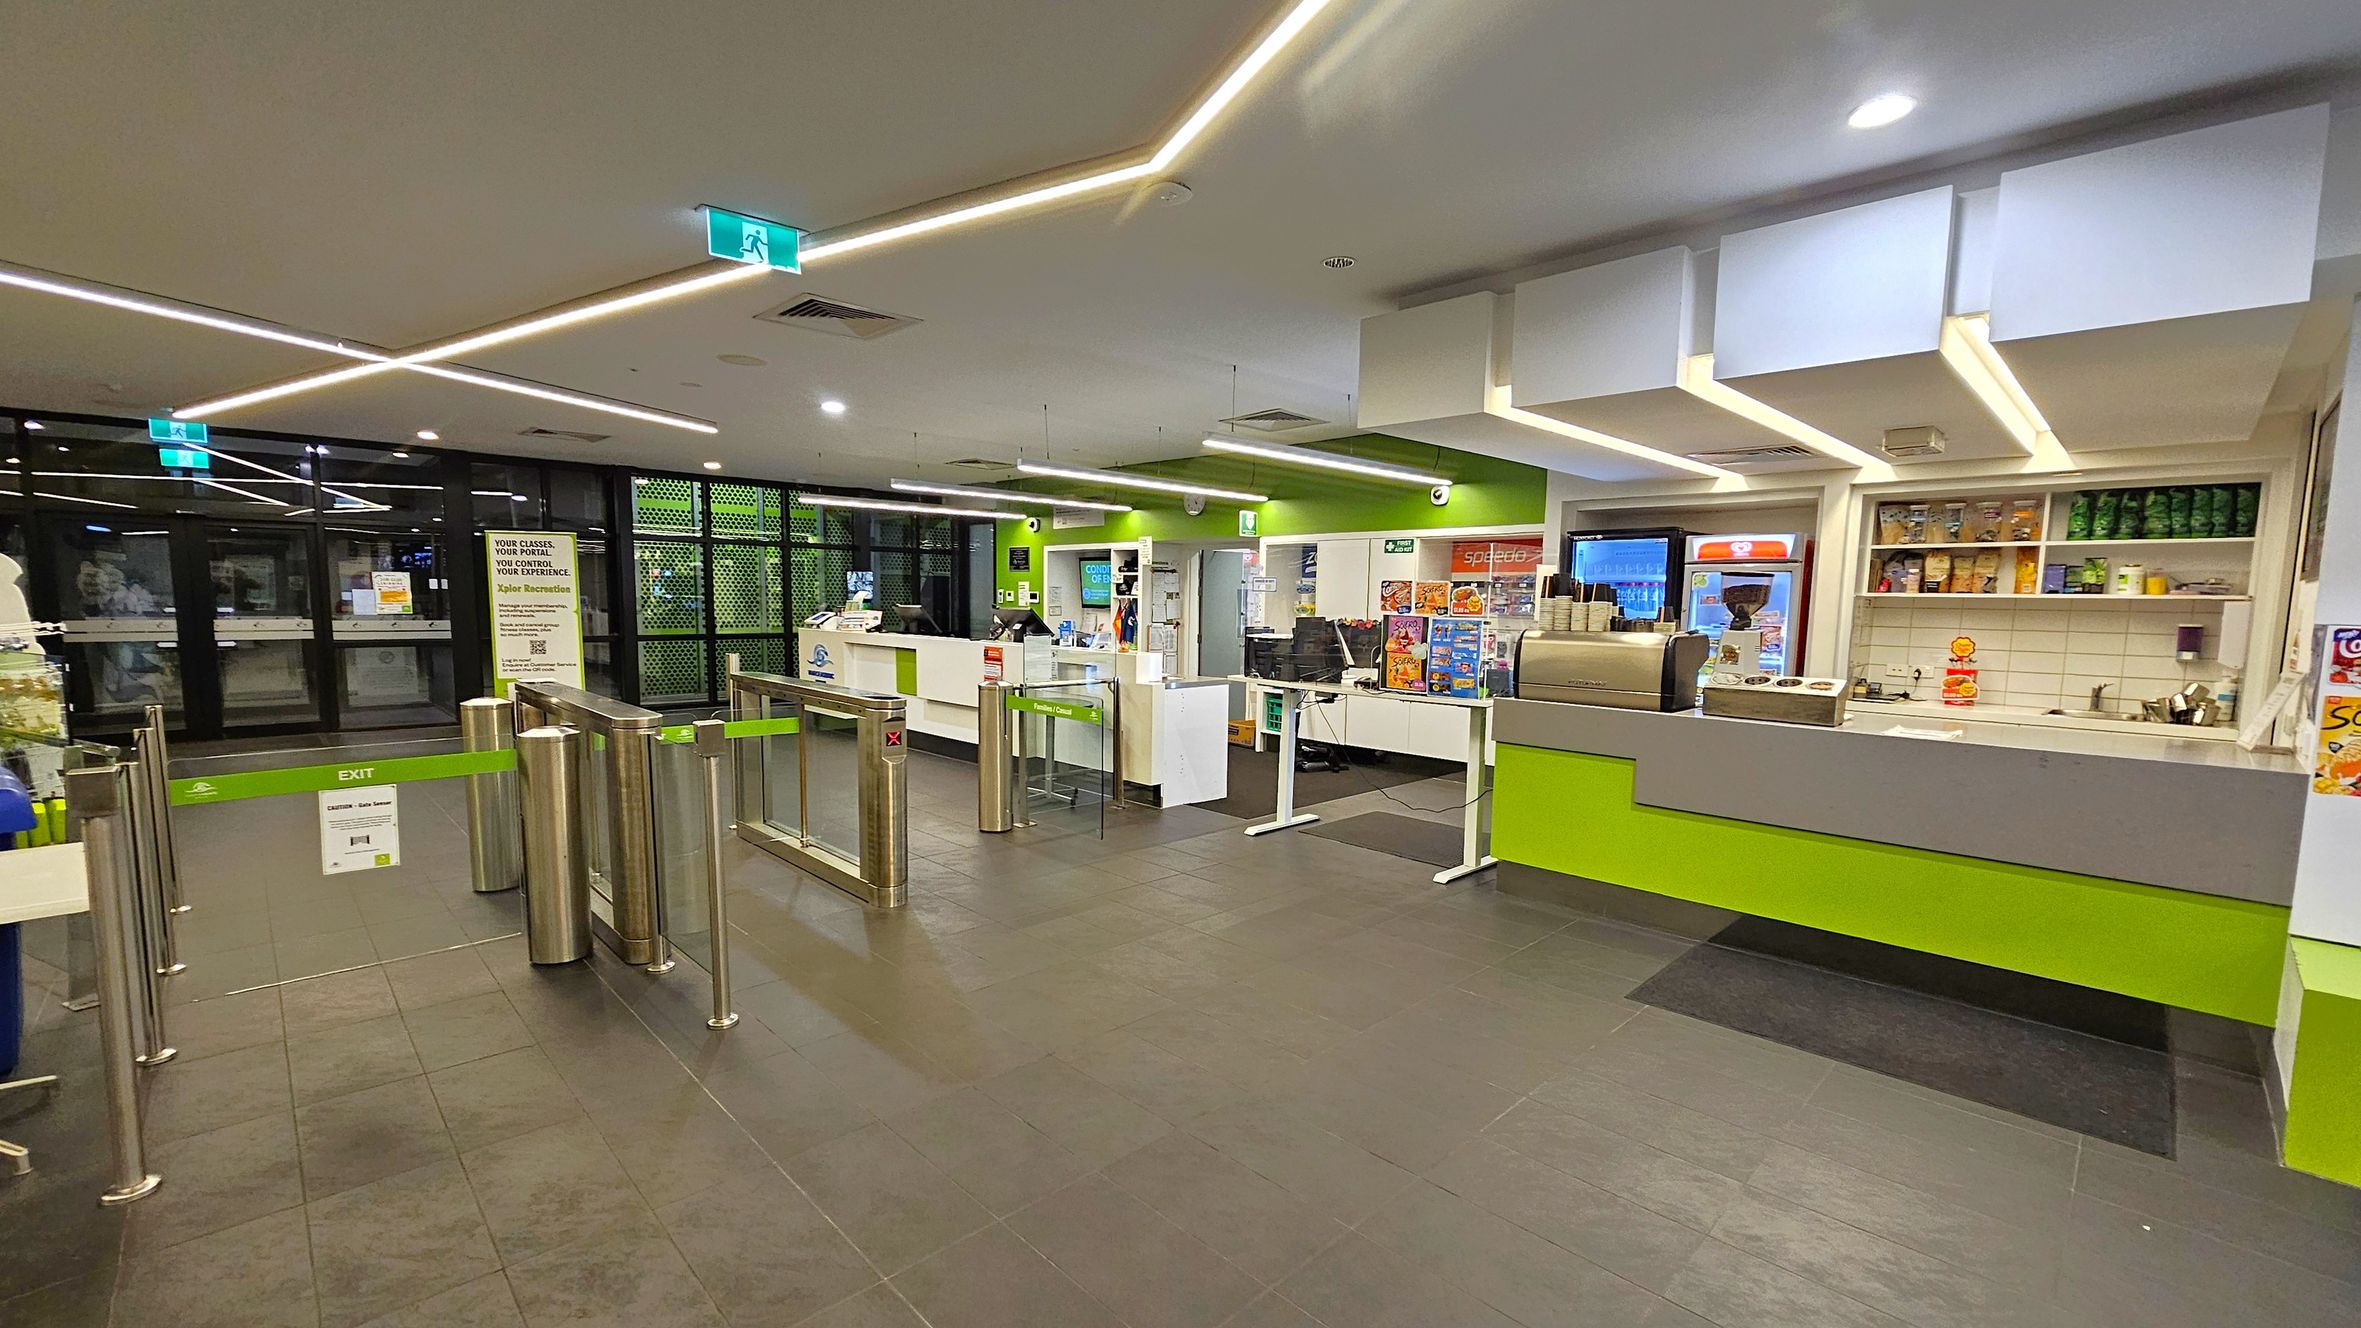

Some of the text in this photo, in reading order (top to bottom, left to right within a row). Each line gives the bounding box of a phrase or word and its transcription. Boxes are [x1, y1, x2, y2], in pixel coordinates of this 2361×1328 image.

[520, 540, 555, 548] CLASSES.
[1464, 550, 1526, 566] speedo
[1092, 574, 1102, 584] OF
[498, 584, 570, 594] Xplor Recreation
[1034, 702, 1052, 712] Families
[1056, 706, 1072, 715] Casual
[338, 767, 375, 781] EXIT
